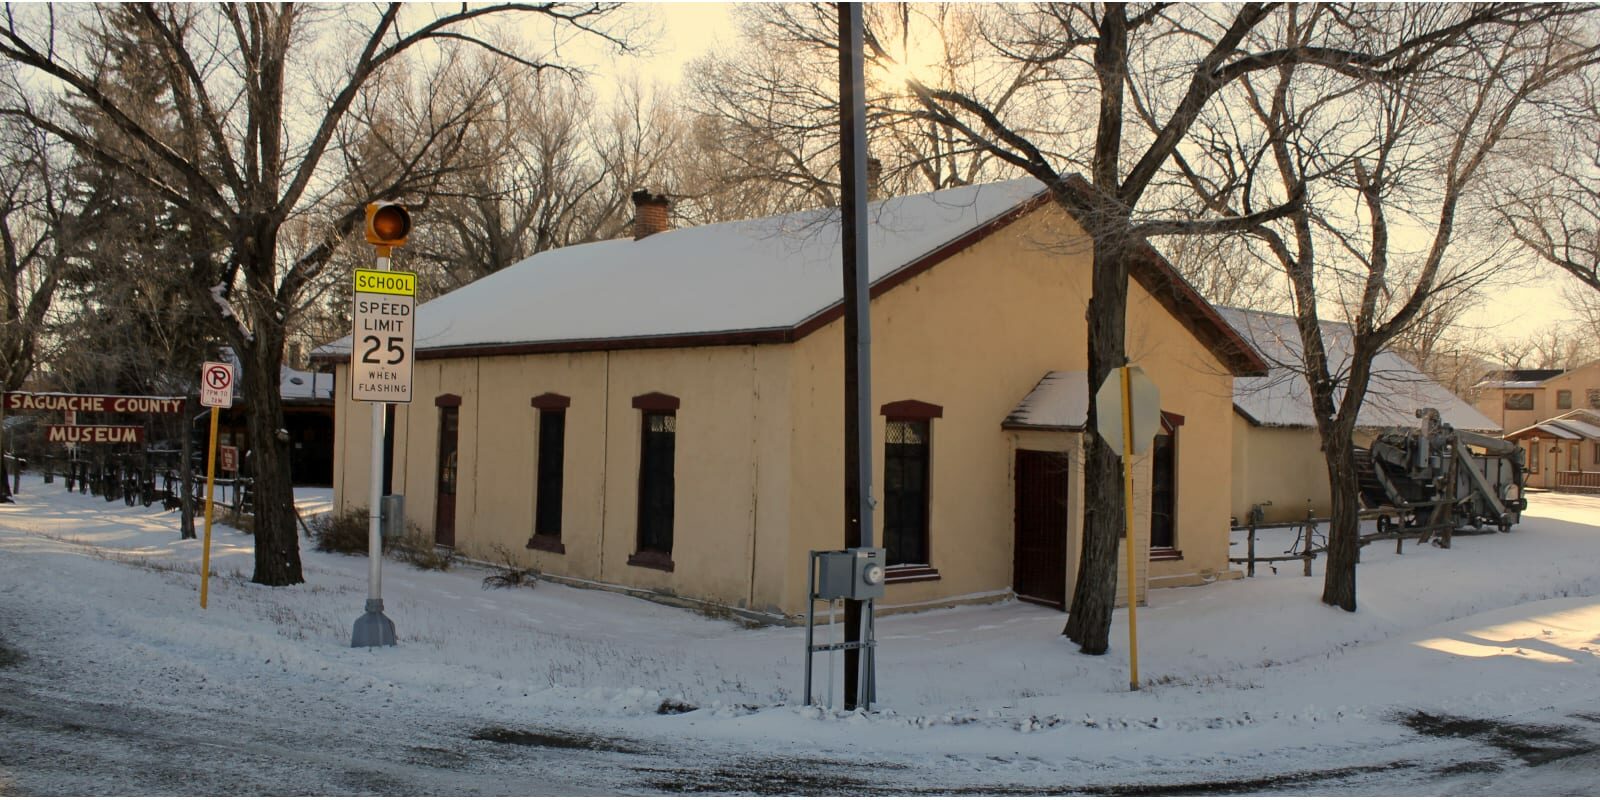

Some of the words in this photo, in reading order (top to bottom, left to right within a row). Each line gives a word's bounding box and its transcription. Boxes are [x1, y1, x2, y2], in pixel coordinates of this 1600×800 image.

[358, 275, 412, 291] SCHOOL
[359, 301, 410, 316] SPEED
[364, 319, 404, 332] LIMIT
[362, 335, 405, 365] 25
[368, 371, 397, 380] WHEN
[358, 383, 407, 393] FLASHING
[10, 394, 104, 411] SAGUACHE
[114, 397, 181, 413] COUNTY
[49, 426, 137, 443] MUSEUM
